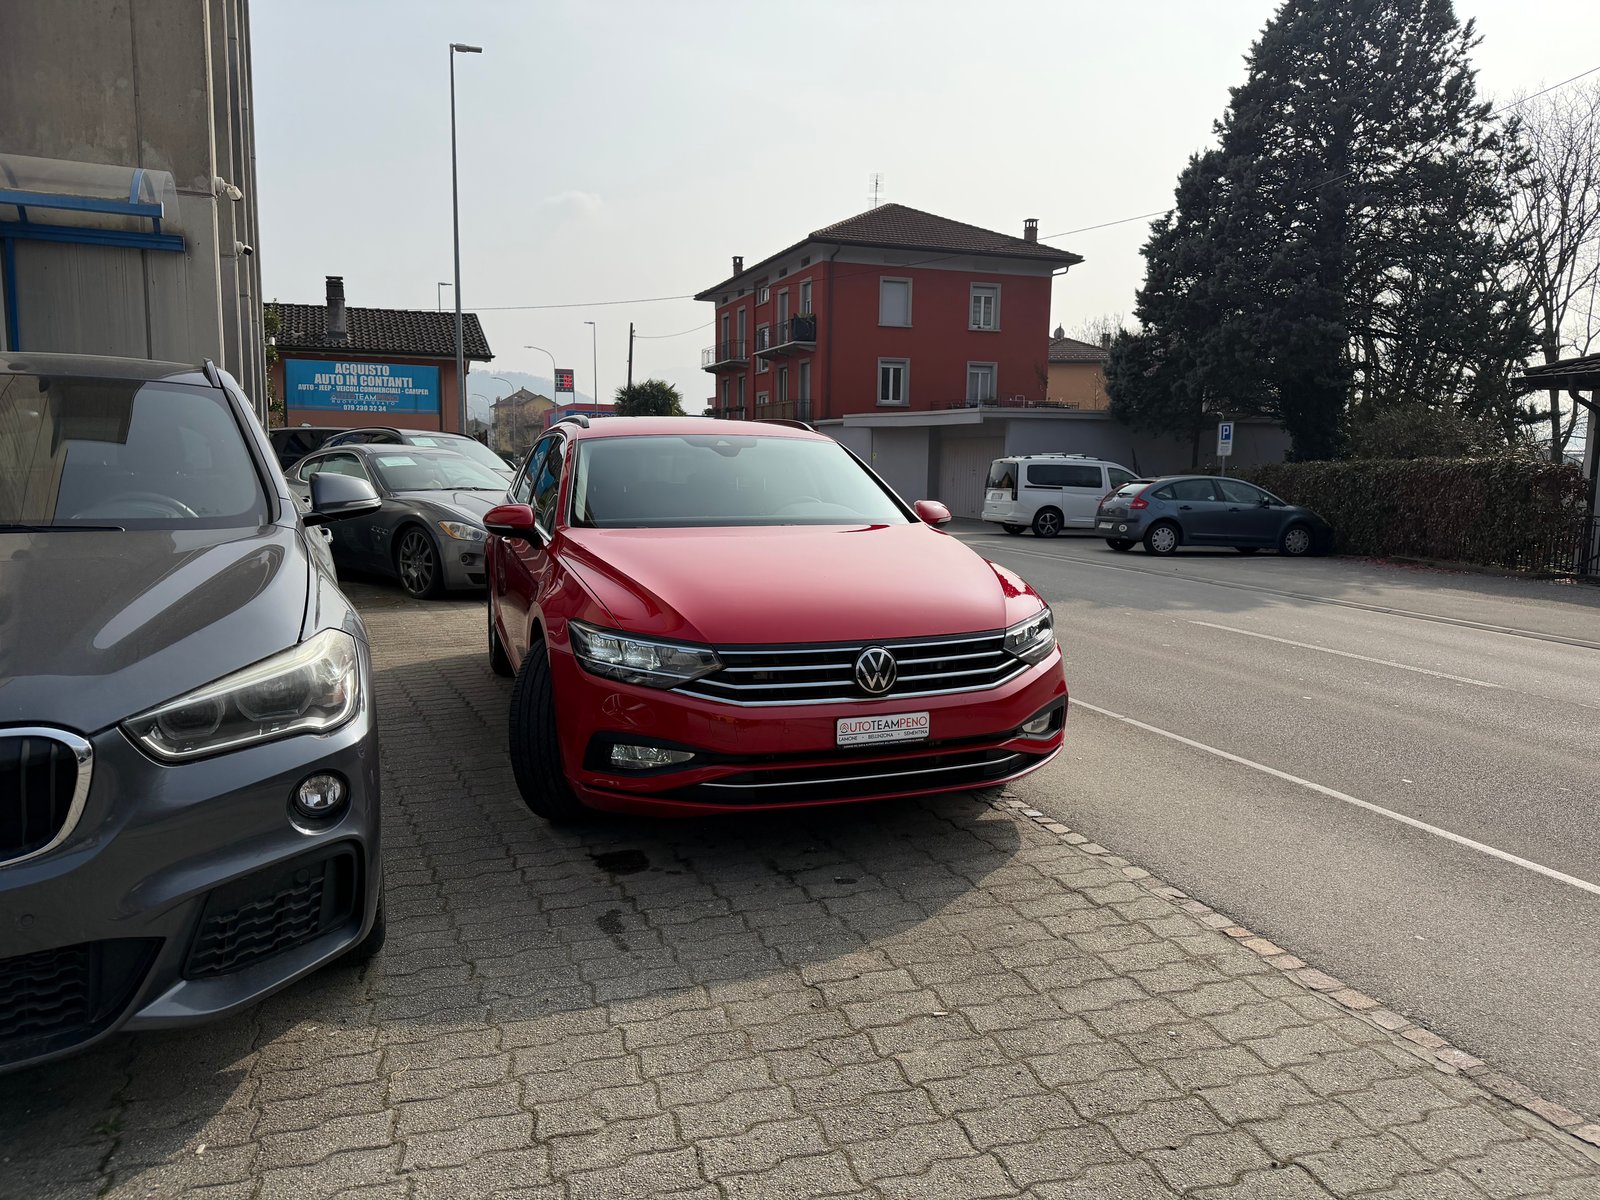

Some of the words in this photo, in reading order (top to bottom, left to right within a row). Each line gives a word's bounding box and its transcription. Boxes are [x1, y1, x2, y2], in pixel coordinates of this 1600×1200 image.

[335, 364, 390, 376] ACQUISTO
[314, 373, 343, 385] AUTO
[346, 375, 357, 386] IN
[360, 375, 413, 388] CONTANTI
[336, 385, 359, 393] VEICOLI
[360, 386, 401, 394] COMMERCIALI
[405, 388, 429, 396] CAMPER
[1222, 426, 1230, 440] P
